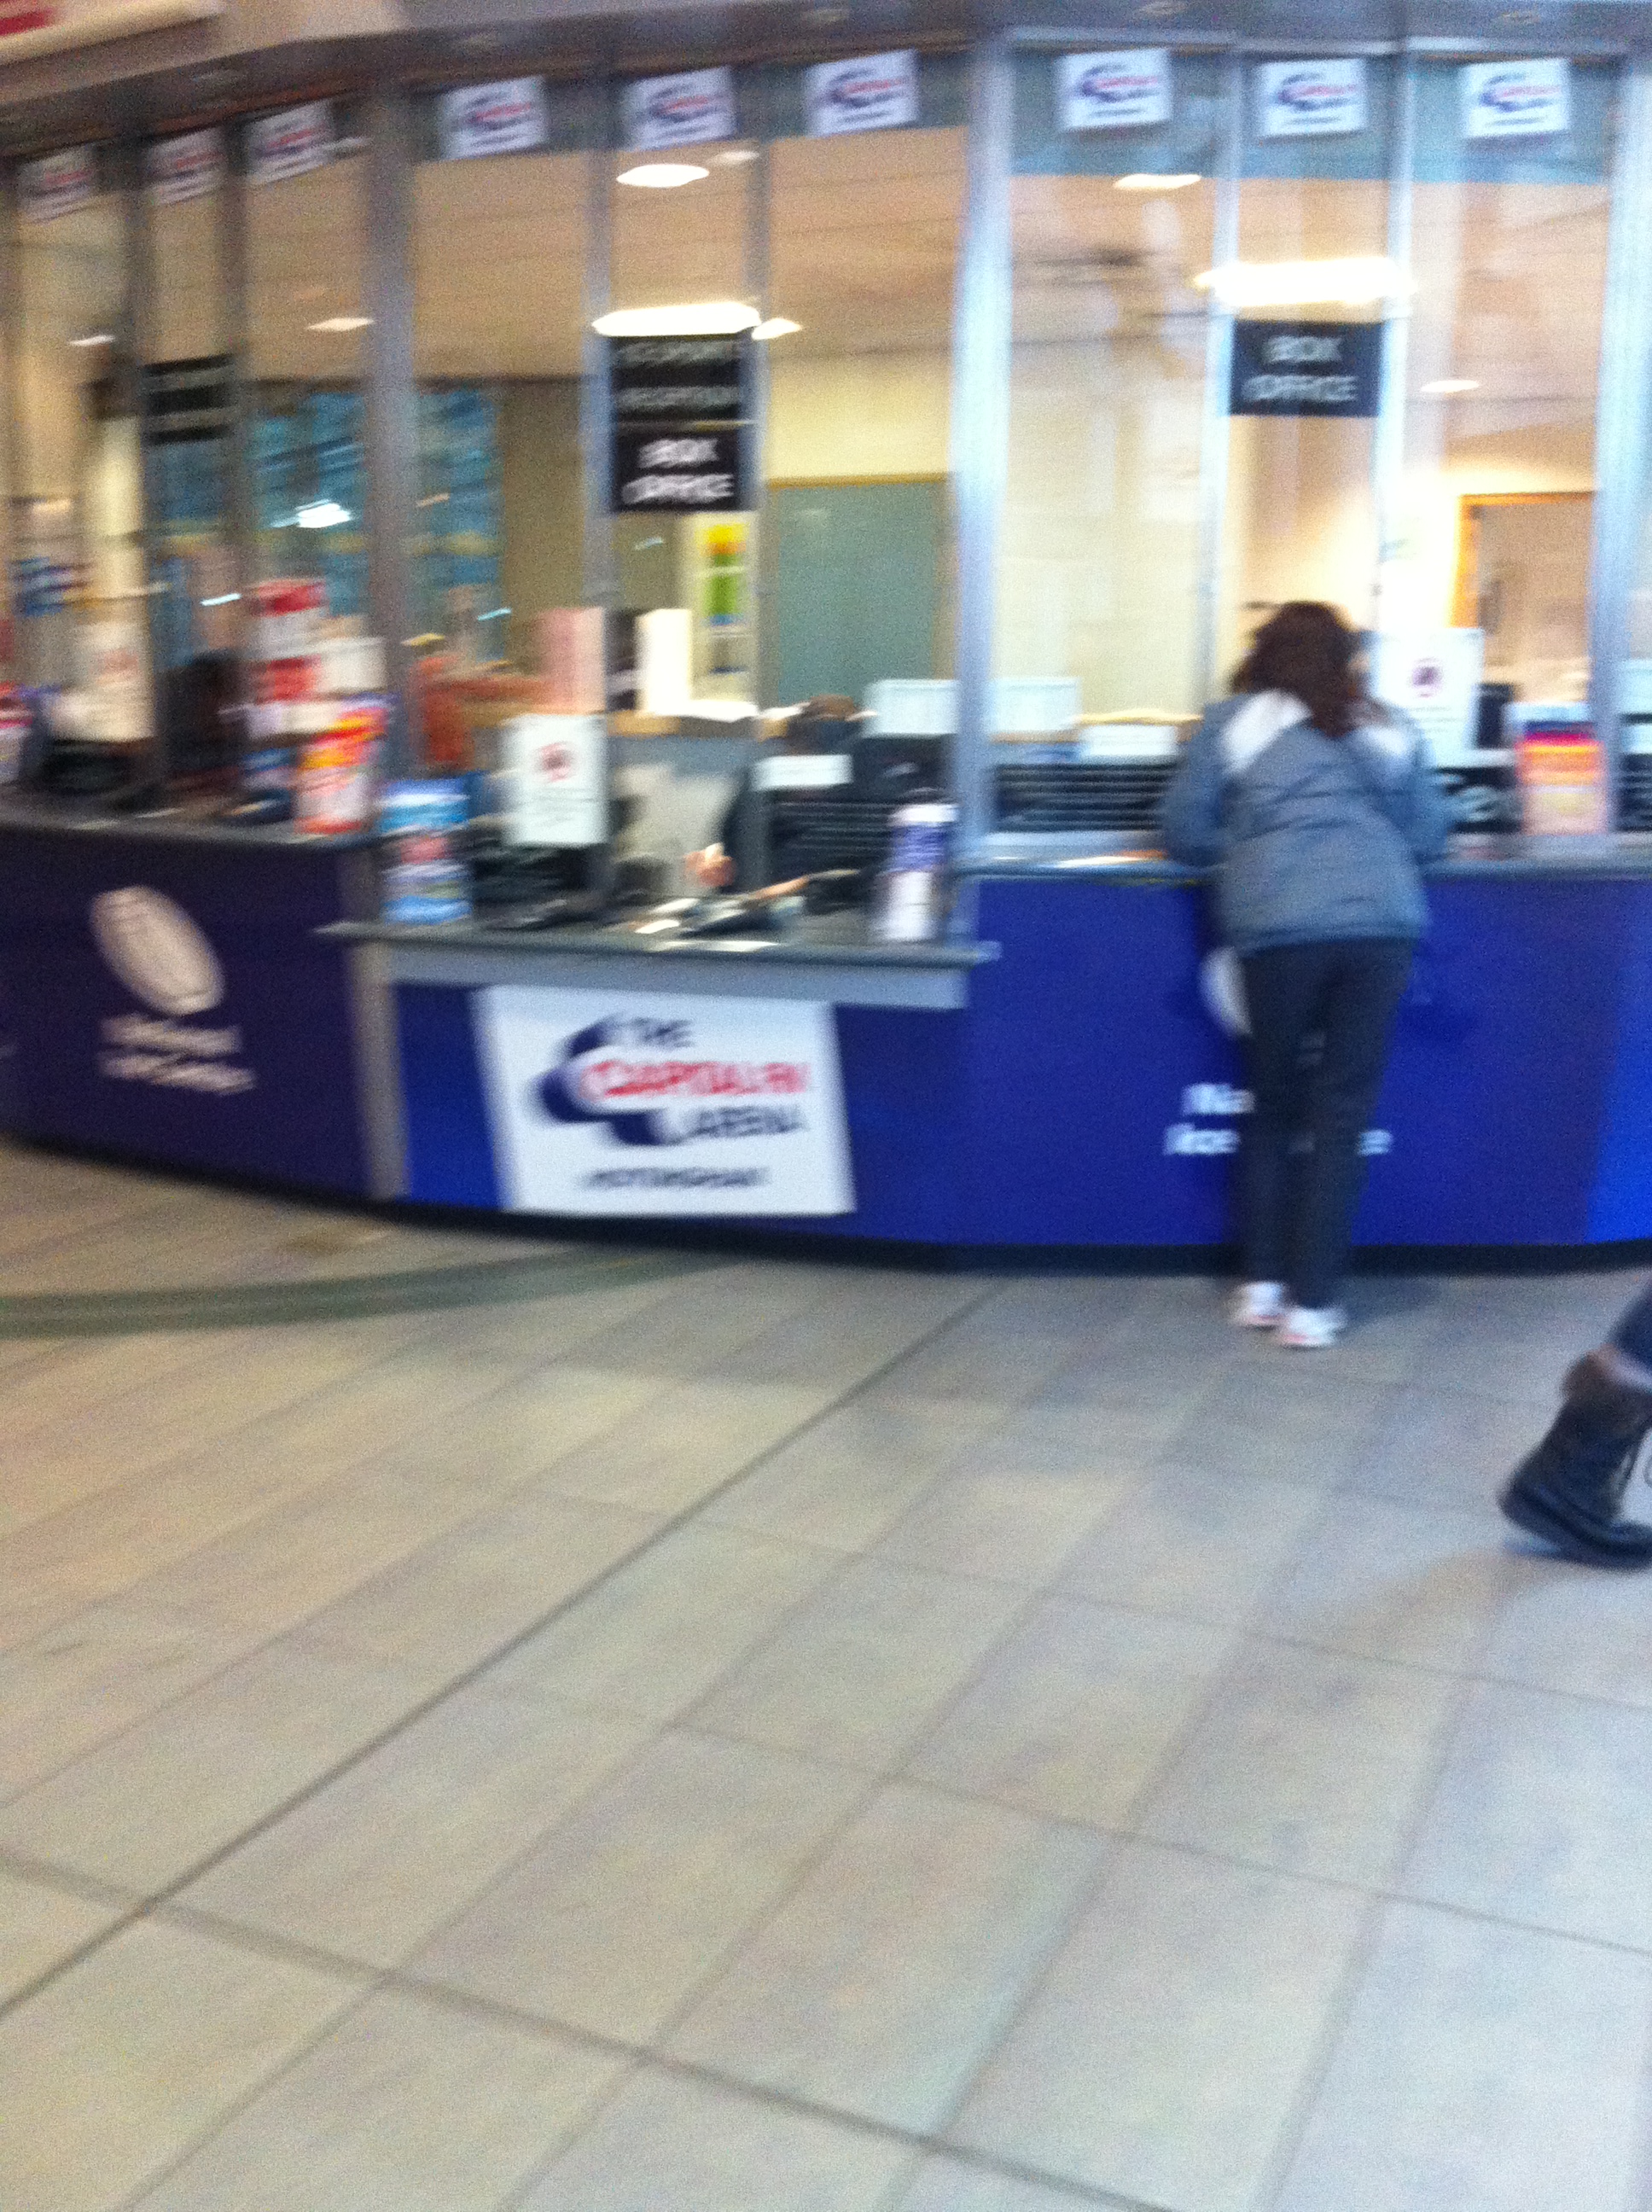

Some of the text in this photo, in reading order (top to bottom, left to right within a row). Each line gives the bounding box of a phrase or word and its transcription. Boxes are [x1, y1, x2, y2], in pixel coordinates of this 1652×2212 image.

[1265, 335, 1343, 364] BOX
[1242, 374, 1358, 403] OFFICE
[638, 438, 718, 469] BOX
[621, 473, 735, 504] OFFICE
